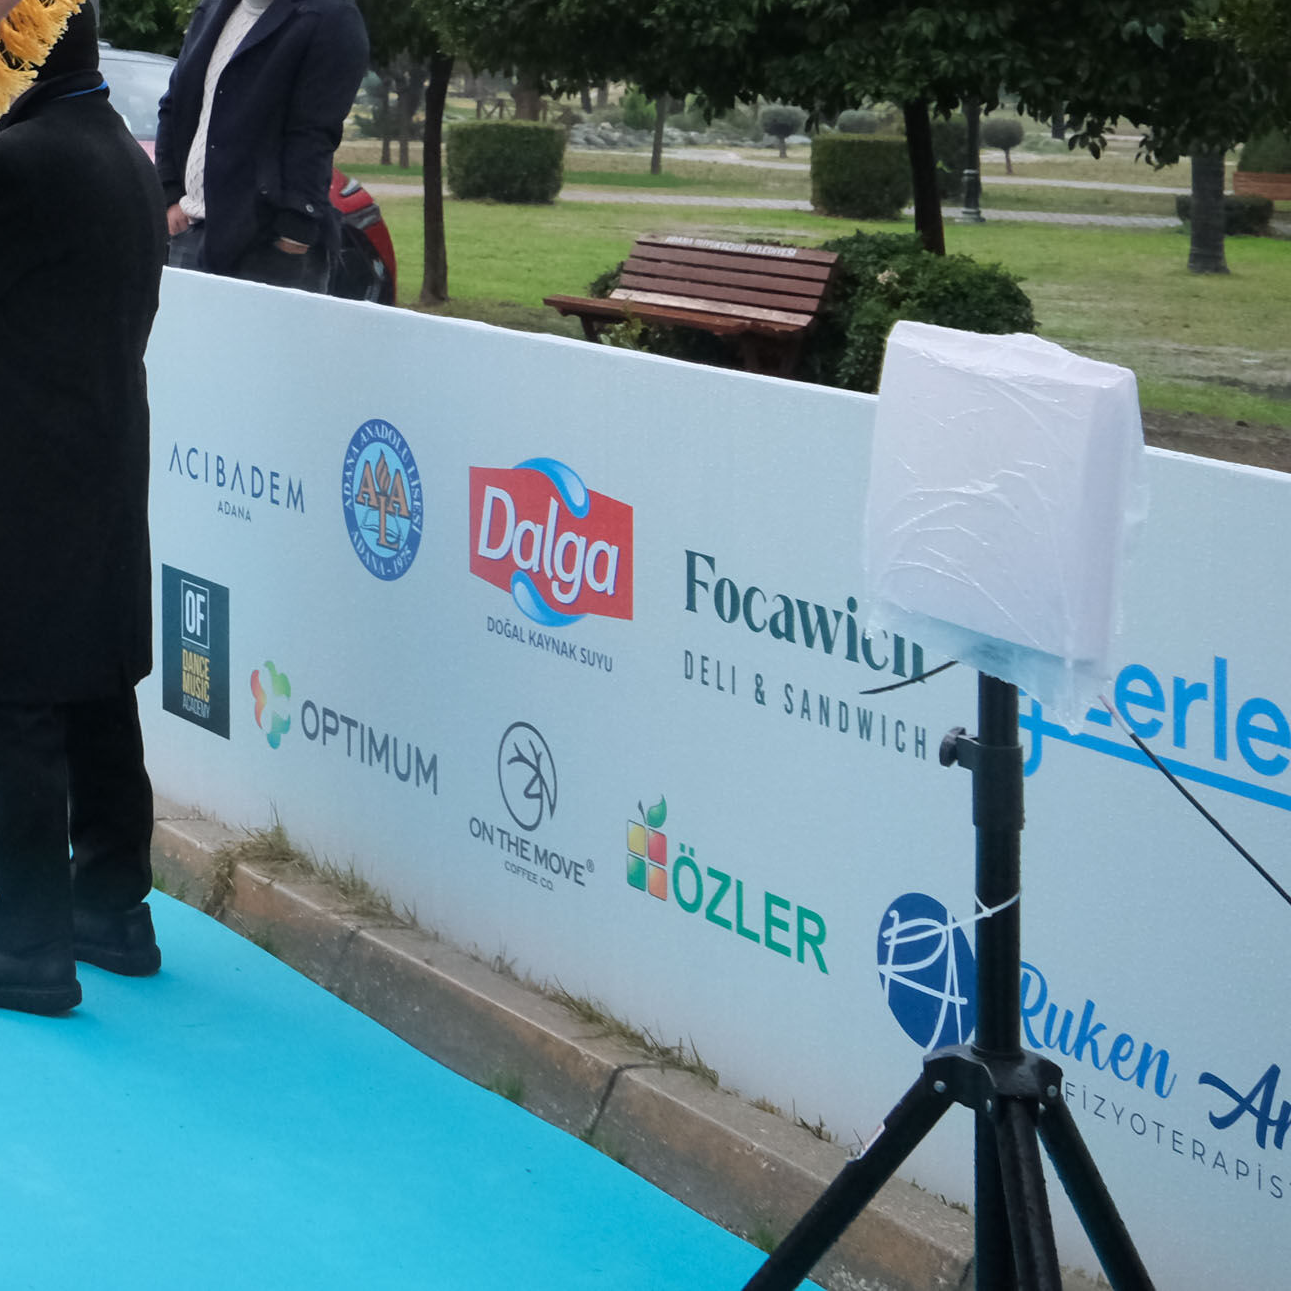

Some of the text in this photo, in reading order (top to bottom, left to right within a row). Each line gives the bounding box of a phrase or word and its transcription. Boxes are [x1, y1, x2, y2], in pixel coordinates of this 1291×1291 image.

[169, 442, 305, 514] ACIBADEM
[217, 500, 252, 523] ADANA
[477, 484, 620, 605] Dalga
[184, 589, 206, 637] OF
[486, 615, 614, 673] DOĞAL KAYNAK SUYU
[182, 649, 210, 681] DANCE
[182, 670, 210, 703] MUSIC
[182, 693, 210, 719] ACADEMY
[684, 649, 927, 761] DELI & SANDWICH
[301, 699, 437, 795] OPTIMUM
[469, 816, 586, 887] ON THE MOVE
[504, 860, 539, 885] COFFEE
[672, 842, 829, 975] ÖZLER
[1021, 960, 1177, 1099] Ruken
[1065, 1082, 1291, 1199] FİZYOTERAPİS
